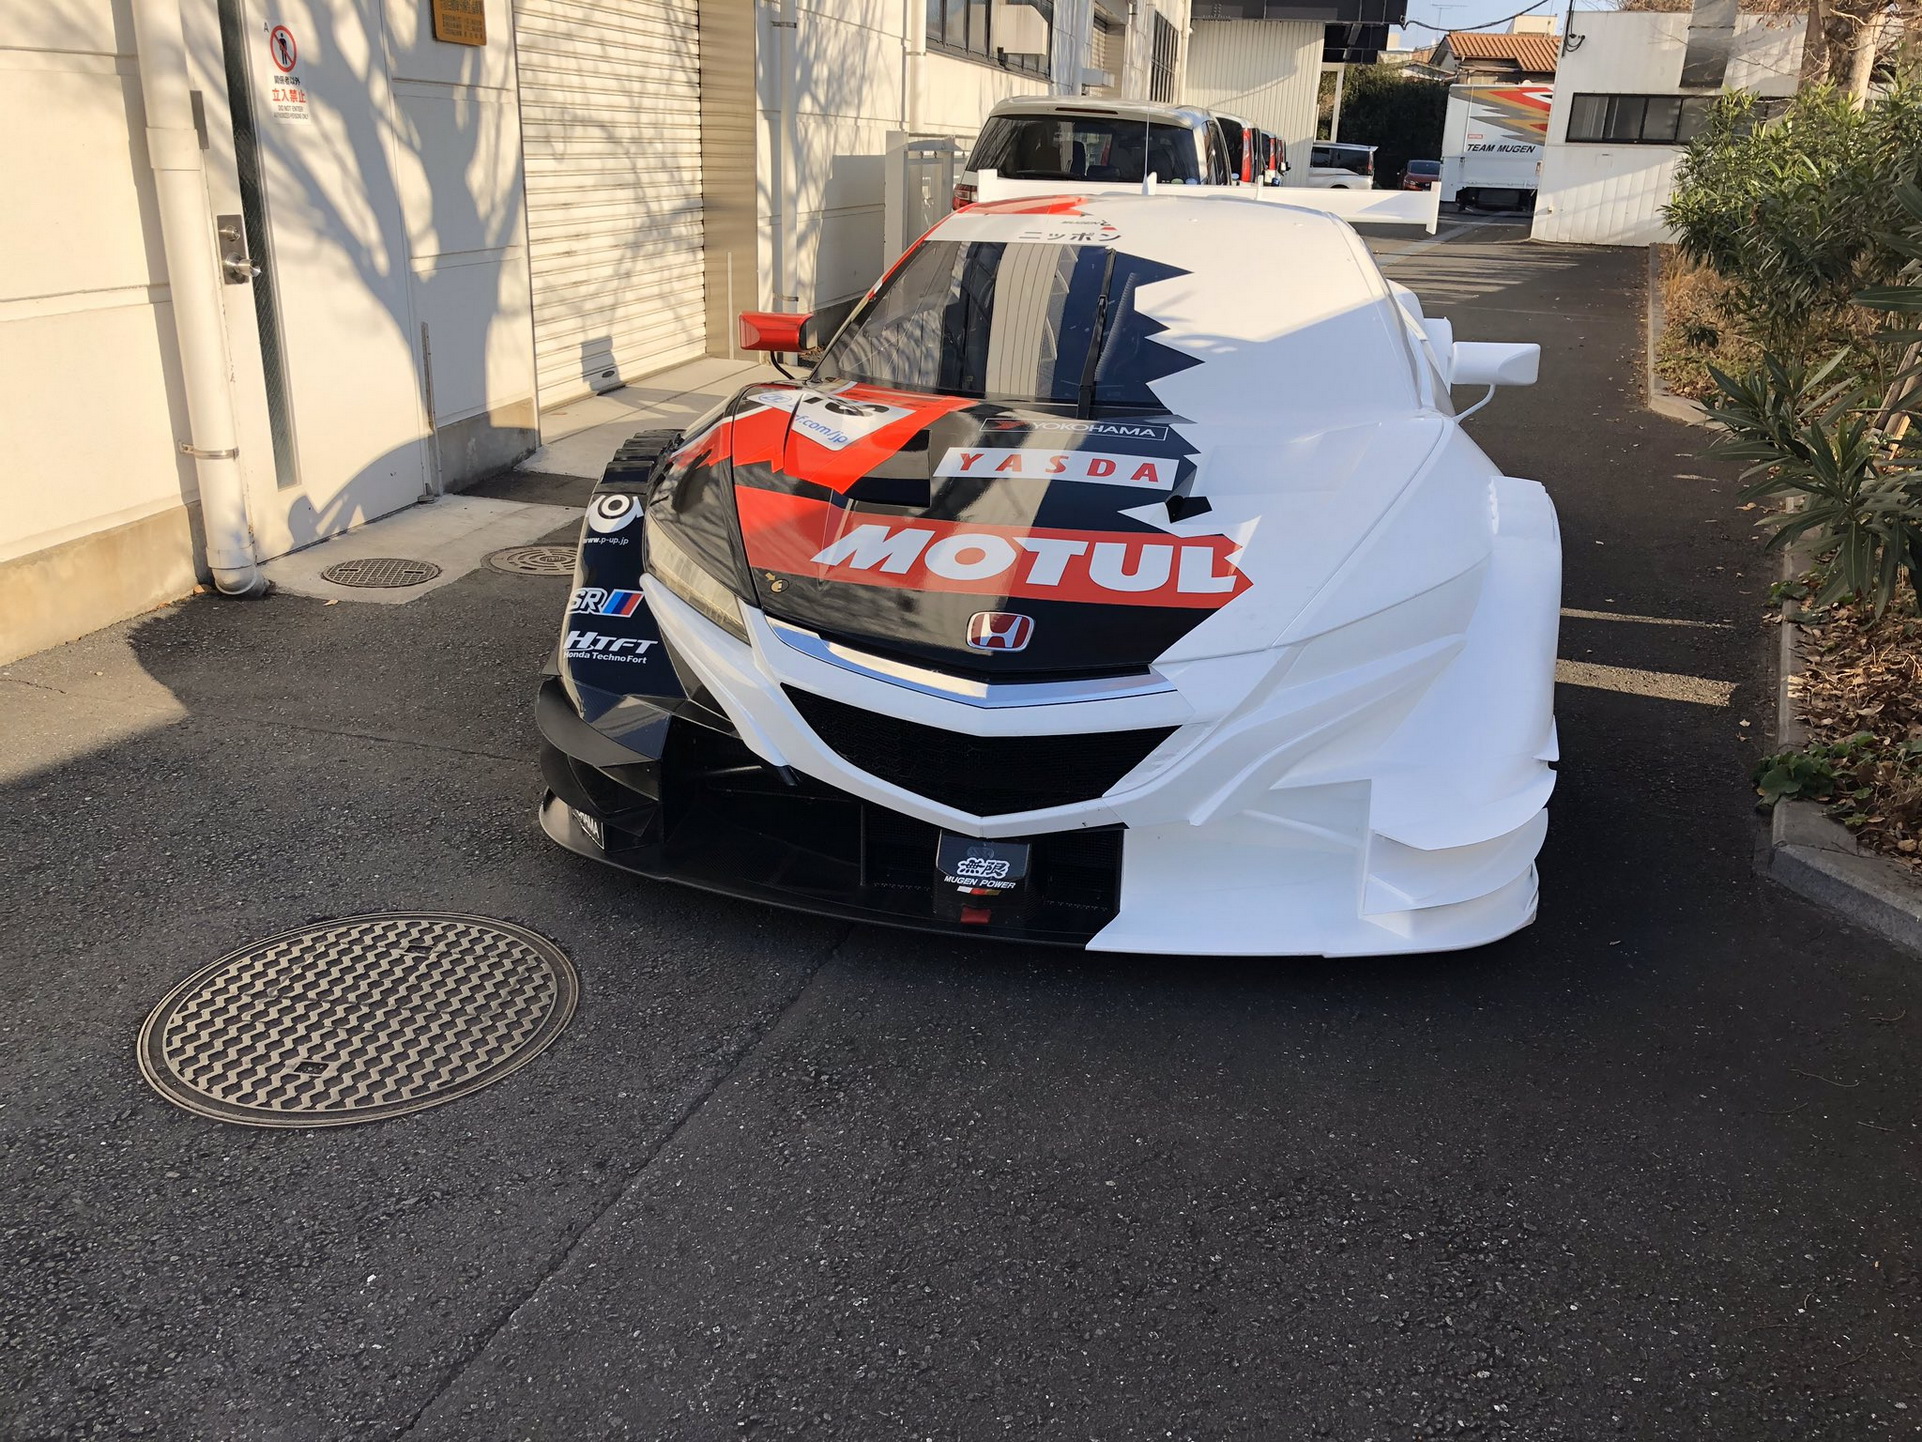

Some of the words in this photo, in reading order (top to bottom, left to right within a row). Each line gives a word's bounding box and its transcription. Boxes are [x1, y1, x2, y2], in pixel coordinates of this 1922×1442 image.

[272, 88, 307, 104] 立入禁止
[1467, 143, 1495, 152] TEAM
[1497, 145, 1536, 153] MUGEN
[1032, 421, 1156, 438] YOKOHAMA
[960, 452, 1160, 483] YASDA
[809, 523, 1238, 594] MOTUL
[944, 875, 978, 886] MUGEN
[979, 879, 1017, 889] POWER
